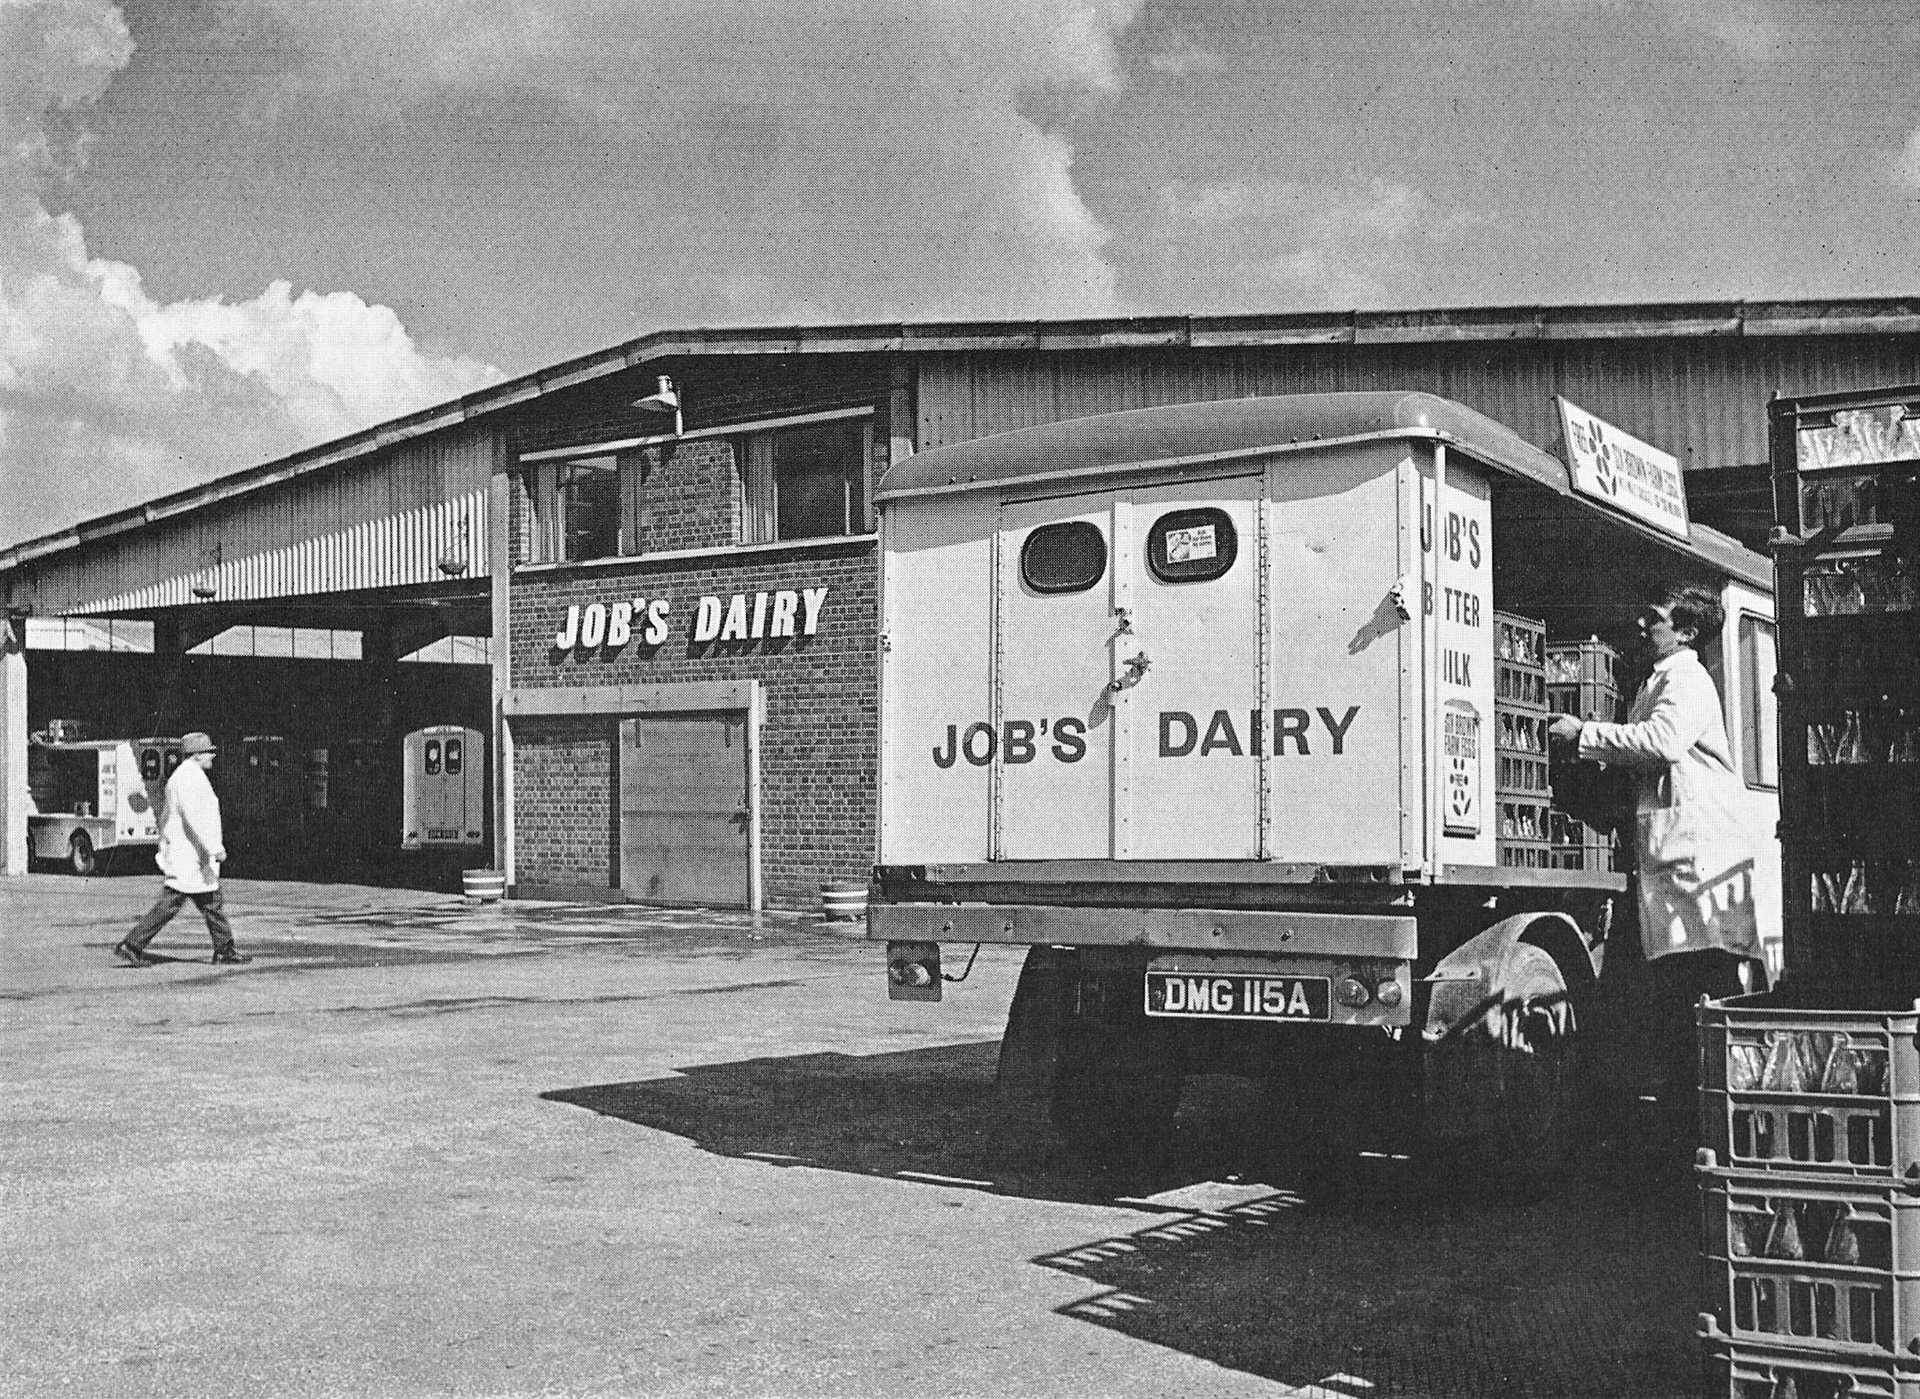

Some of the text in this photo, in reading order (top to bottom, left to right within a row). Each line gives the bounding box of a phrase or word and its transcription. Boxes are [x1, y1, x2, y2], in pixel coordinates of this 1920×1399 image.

[1421, 504, 1481, 569] JB'S
[556, 587, 829, 649] JOB'S DAIRY
[1423, 580, 1480, 628] BTTER
[932, 706, 1361, 769] JOB'S DAIRY
[1164, 977, 1310, 1015] DMG 115A
